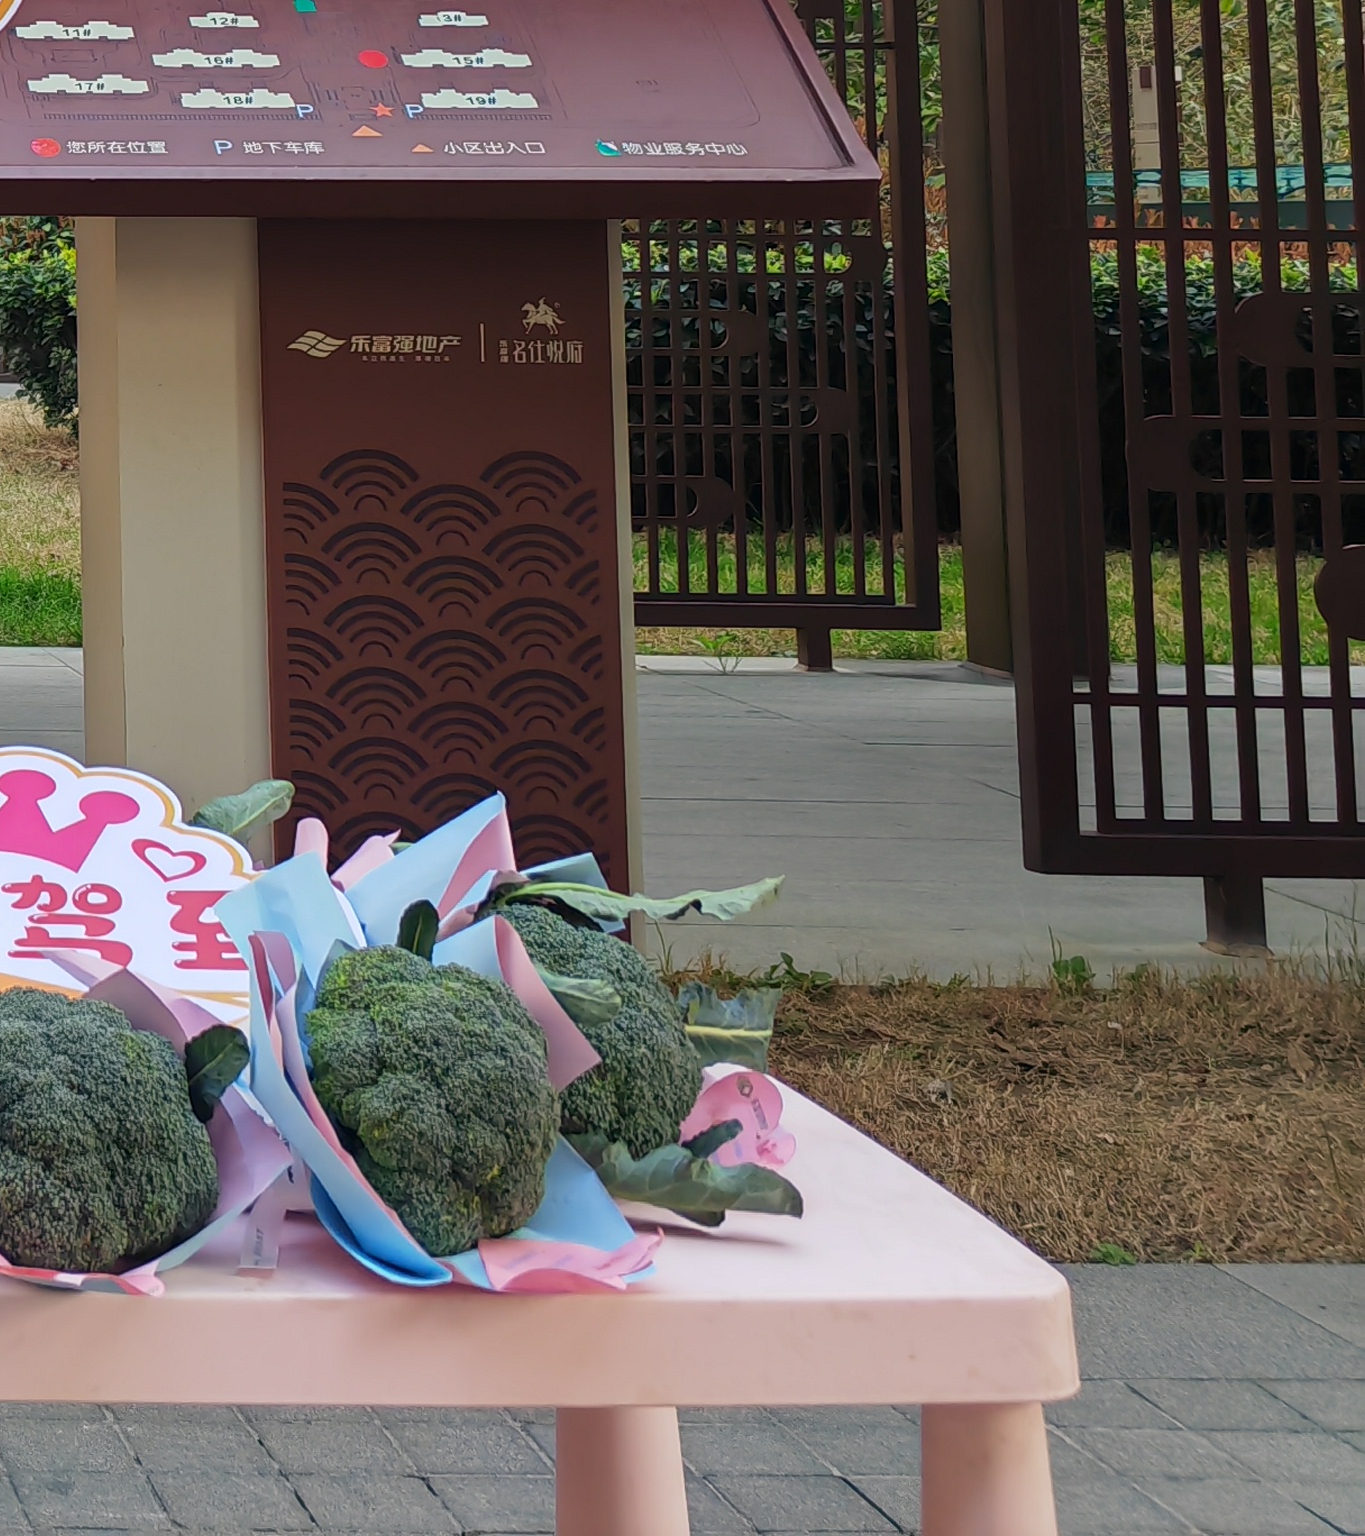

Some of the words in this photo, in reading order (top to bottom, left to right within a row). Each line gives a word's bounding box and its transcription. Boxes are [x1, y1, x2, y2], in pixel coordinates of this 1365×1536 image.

[210, 17, 240, 26] 12#
[62, 28, 91, 37] 11#
[204, 56, 234, 65] 16#
[452, 56, 484, 65] 15#
[75, 81, 105, 90] 17#
[223, 96, 254, 105] 18#
[465, 96, 497, 105] 19#
[296, 104, 314, 118] P
[405, 104, 423, 118] P
[66, 140, 168, 154] 您所在位置
[214, 140, 233, 154] P
[243, 140, 324, 154] 地下车库
[443, 141, 546, 154] 小区出入口
[622, 142, 747, 156] 物业服务中心
[349, 335, 462, 354] 乐富强地产
[513, 340, 584, 364] 名仕悦府
